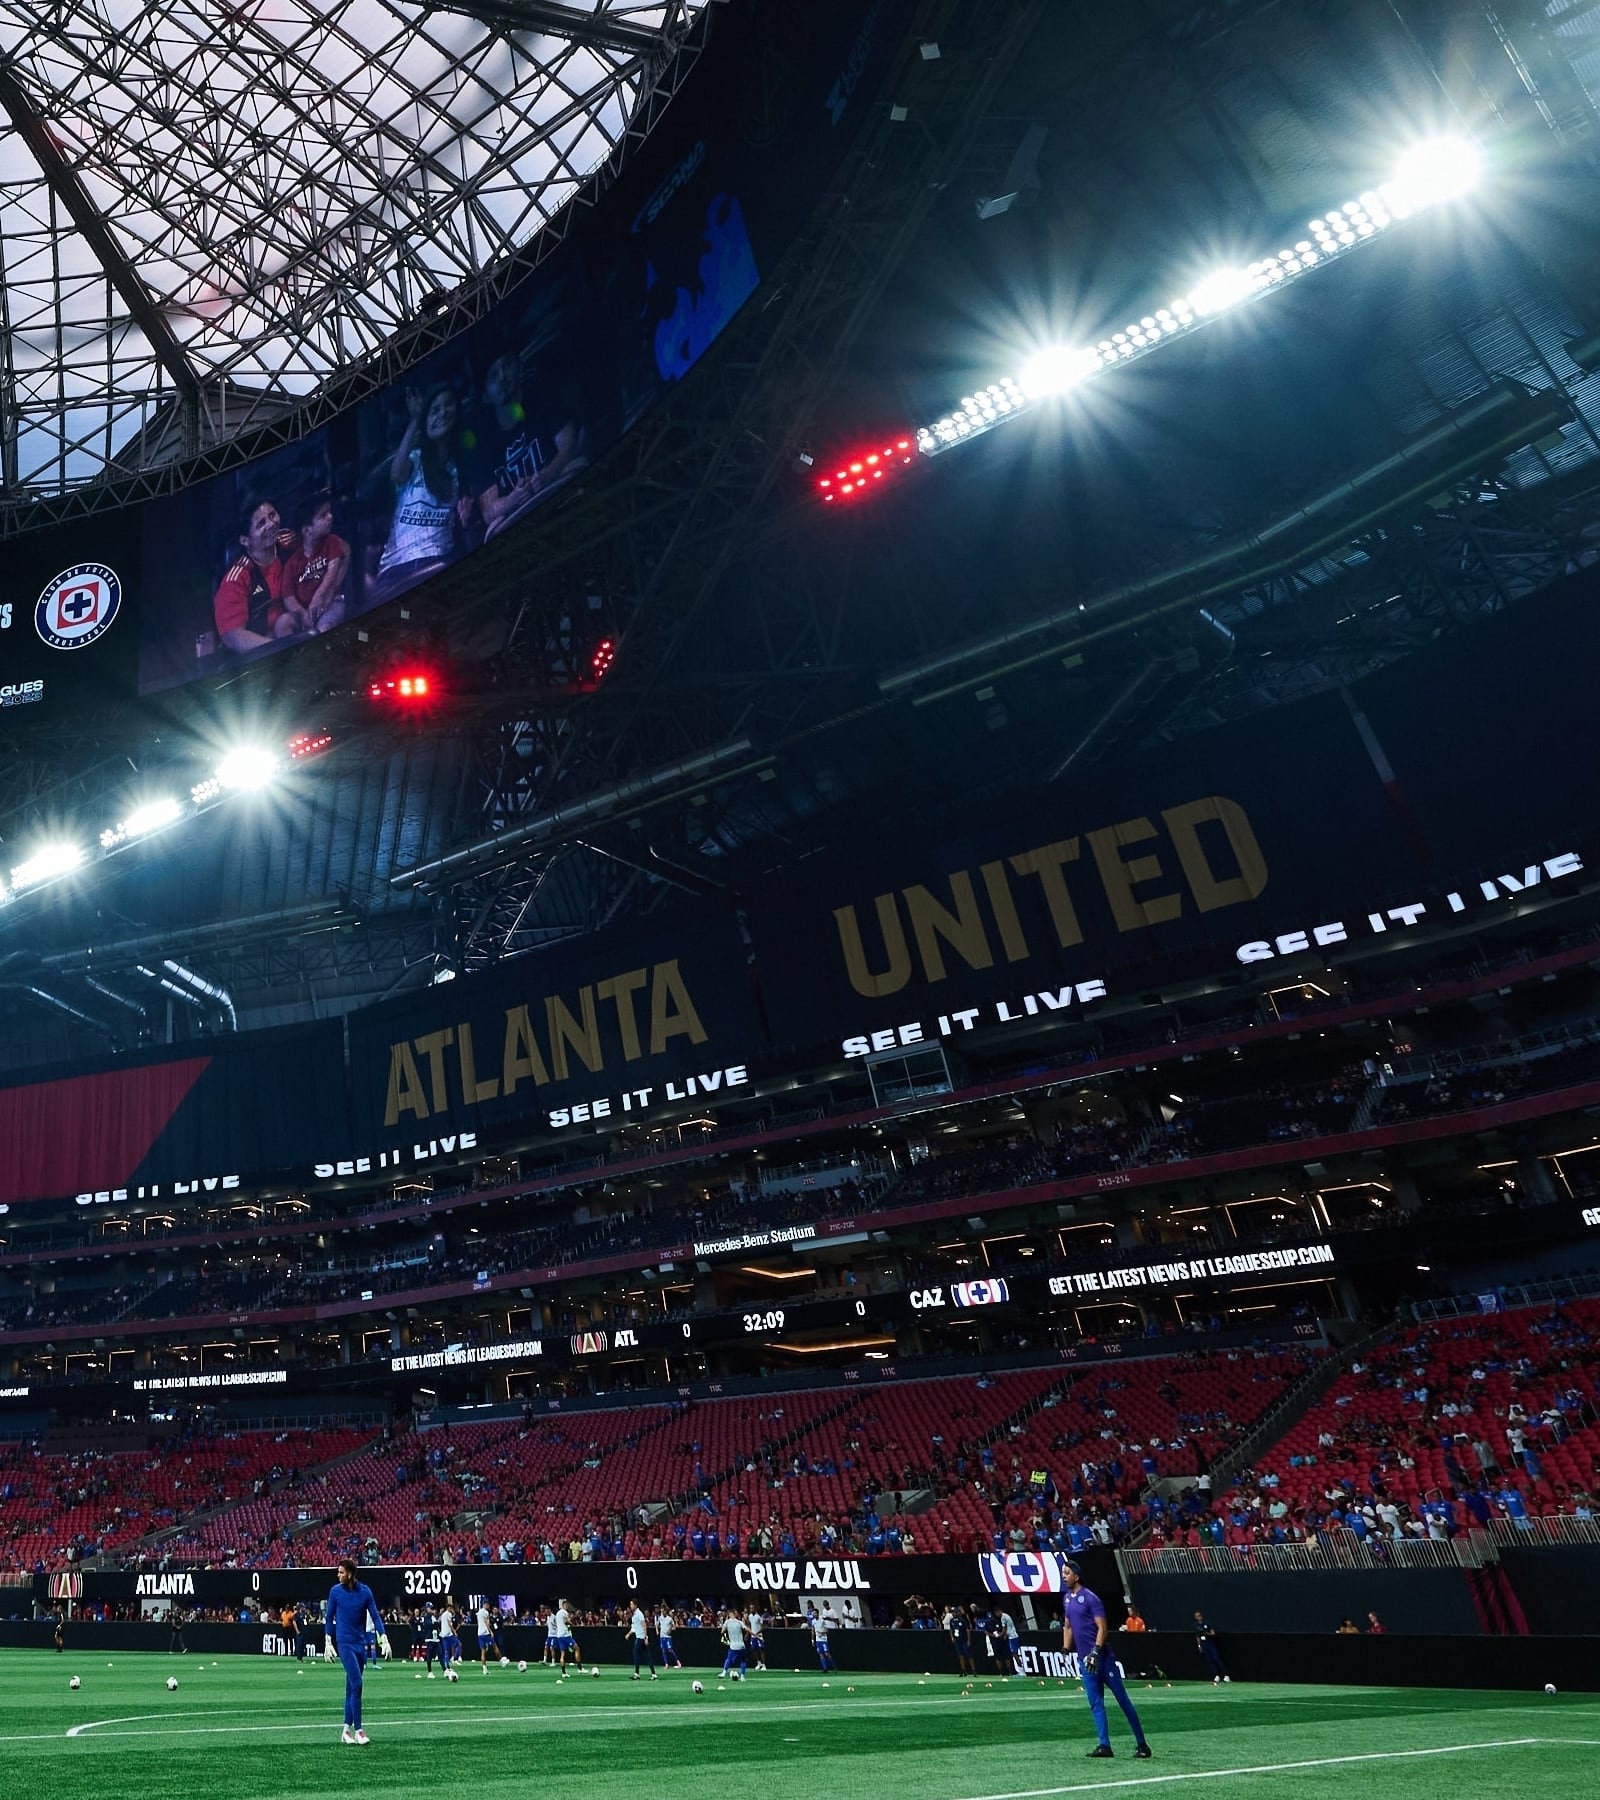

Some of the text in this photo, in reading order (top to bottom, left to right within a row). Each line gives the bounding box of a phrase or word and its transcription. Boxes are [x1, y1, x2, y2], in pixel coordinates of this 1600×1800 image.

[49, 623, 106, 647] CRUZ AZUL
[832, 795, 1269, 997] UNITED
[1368, 902, 1427, 933] IT
[842, 979, 1107, 1058] SEE IT LIVE
[384, 958, 709, 1127] ATLANTA
[1394, 1044, 1412, 1054] 215
[549, 1065, 748, 1128] SEE IT LIVE
[414, 1132, 477, 1160] LIVE
[1097, 1175, 1130, 1187] 213-214
[693, 1225, 815, 1257] Mercedes-Benz Stadium
[1048, 1244, 1335, 1295] GET THE LATEST NEWS AT LEAGUESCUP.COM
[910, 1287, 945, 1309] CAZ
[615, 1330, 638, 1348] ATL
[743, 1311, 785, 1332] 32:09
[1293, 1325, 1316, 1335] 112C
[391, 1340, 543, 1371] GET THE LATEST NEWS AT LEAGUESCUP.COM
[1103, 1344, 1122, 1354] 112C
[135, 1573, 195, 1595] ATLANTA
[252, 1573, 260, 1591] 0
[404, 1570, 451, 1594] 32:09
[626, 1567, 637, 1589] 0
[735, 1561, 800, 1591] CRUZ
[804, 1560, 870, 1590] AZUL
[262, 1634, 277, 1654] GET
